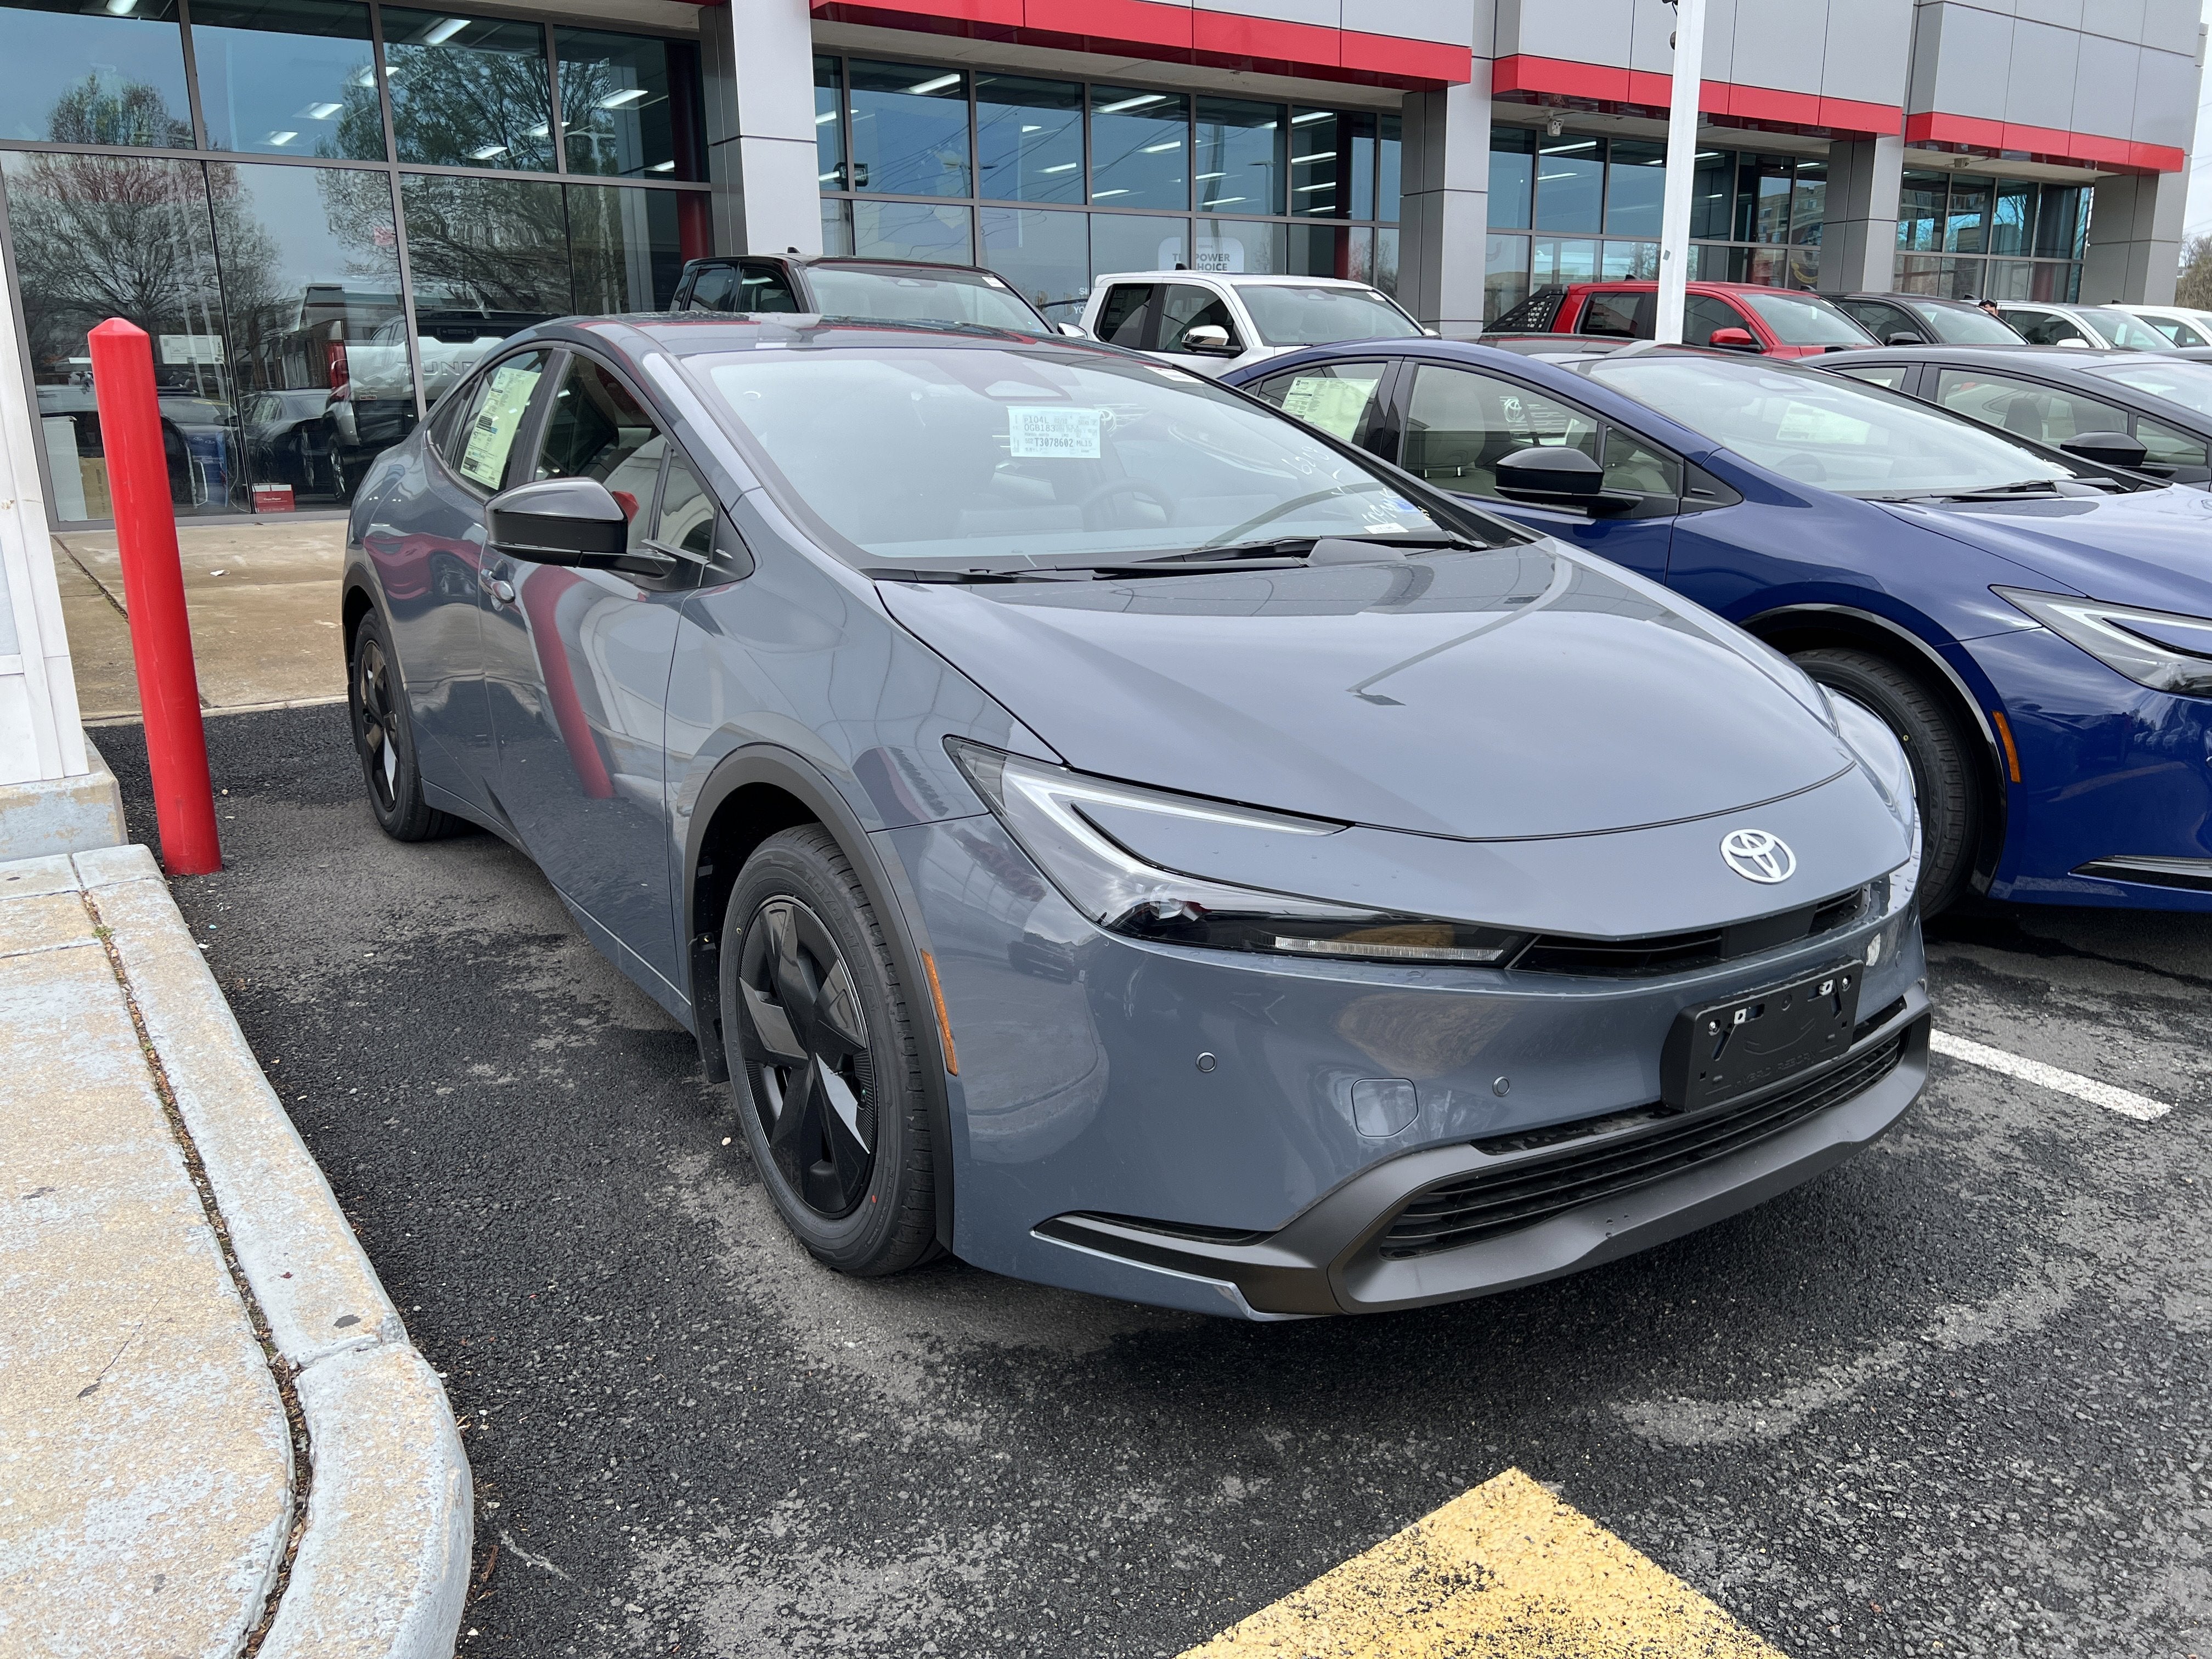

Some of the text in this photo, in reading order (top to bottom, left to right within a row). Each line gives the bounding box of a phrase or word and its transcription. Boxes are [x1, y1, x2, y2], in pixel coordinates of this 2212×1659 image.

[1195, 253, 1230, 262] POWER
[1197, 263, 1228, 271] HOICE
[1034, 437, 1073, 447] T3078602
